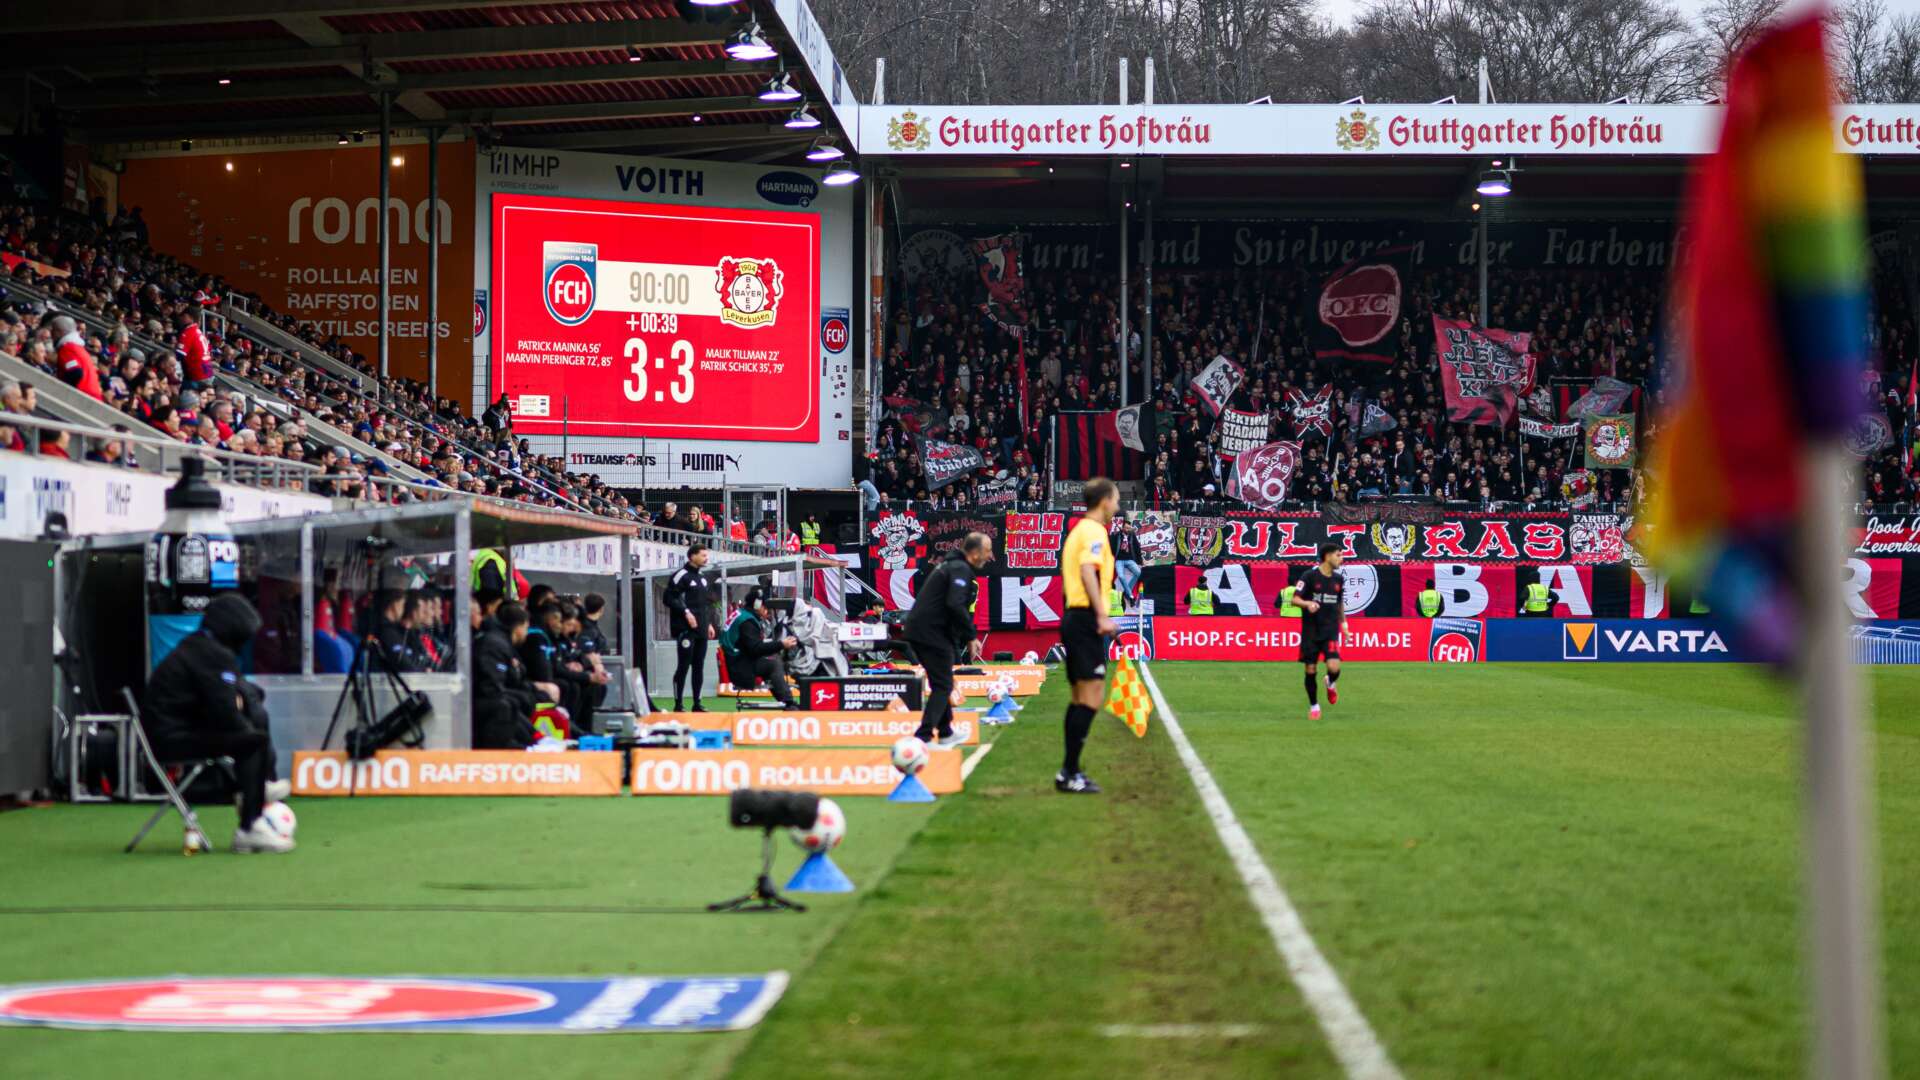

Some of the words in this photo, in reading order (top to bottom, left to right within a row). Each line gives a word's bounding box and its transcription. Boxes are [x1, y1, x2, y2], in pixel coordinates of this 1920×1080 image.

[939, 114, 1091, 151] Stuttgarter
[1099, 114, 1211, 150] Hofbräu
[1387, 114, 1543, 152] Stuttgarter
[1549, 114, 1664, 150] Hofbräu
[1842, 114, 1920, 151] Stutt
[513, 152, 561, 177] MHP
[616, 165, 703, 196] VOITH
[761, 181, 814, 195] HARTMANN
[289, 197, 453, 245] roma
[554, 280, 587, 305] FCH
[629, 270, 690, 305] 90:00
[626, 312, 678, 334] +00:39
[726, 310, 770, 323] Leverkusen
[826, 318, 844, 343] FCH
[518, 340, 551, 352] PATRICK
[553, 341, 587, 353] MAINKA
[589, 343, 602, 354] 56'
[705, 348, 731, 360] MALIK
[733, 349, 767, 361] TILLMAN
[768, 351, 780, 361] 22'
[506, 353, 541, 364] MARVIN
[542, 354, 585, 366] PIERINGER
[601, 356, 613, 367] 85'
[623, 337, 694, 404] 3:3
[700, 360, 727, 372] PATRIK
[729, 361, 758, 373] SCHICK
[772, 364, 785, 374] 79'
[1222, 421, 1269, 440] STADION
[682, 453, 725, 472] PUMA
[1438, 643, 1470, 663] FCH
[1604, 629, 1729, 654] VARTA
[843, 684, 859, 692] DIE
[860, 684, 907, 692] OFFIZIELLE
[843, 693, 899, 701] BUNDESLIGA
[843, 702, 864, 710] APP
[736, 716, 821, 741] roma
[297, 757, 409, 789] roma
[419, 762, 582, 784] RAFFSTOREN
[636, 759, 750, 792] roma
